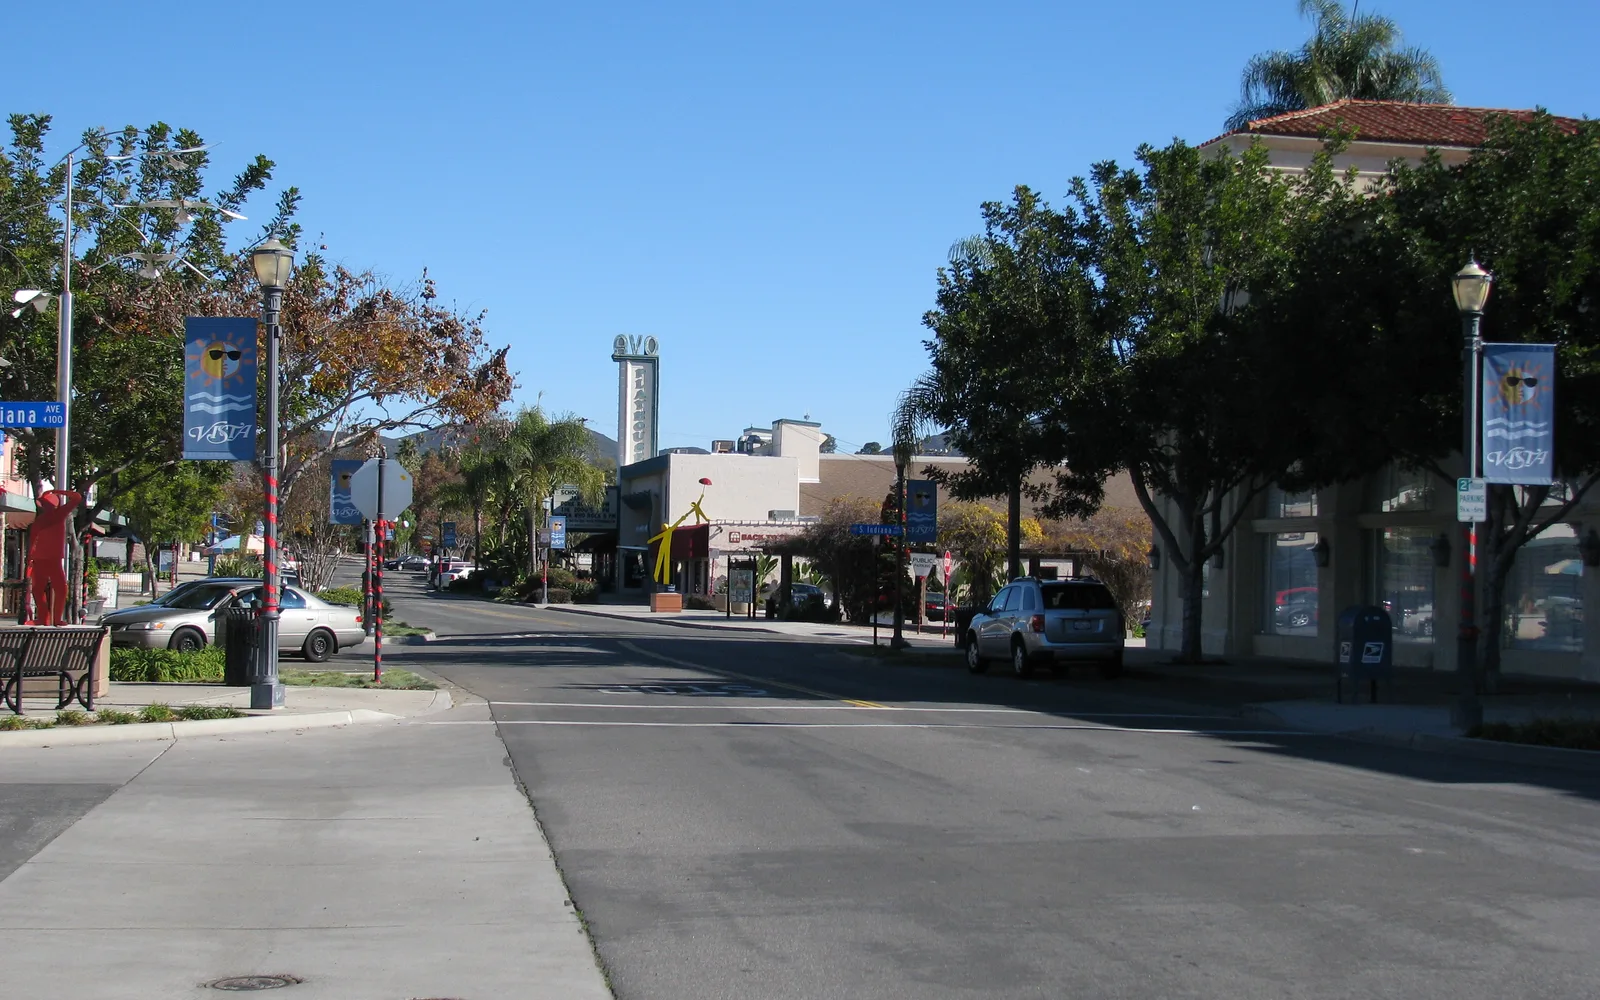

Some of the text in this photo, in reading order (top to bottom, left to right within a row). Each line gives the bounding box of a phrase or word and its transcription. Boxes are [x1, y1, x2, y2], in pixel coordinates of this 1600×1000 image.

[613, 334, 659, 355] AVO
[45, 405, 61, 413] AVE
[49, 416, 63, 424] 100
[633, 368, 646, 463] PLAYHOUSE
[188, 421, 252, 445] VISTA
[1486, 446, 1549, 470] VISTA
[1460, 480, 1468, 490] 2
[1459, 494, 1484, 503] PARKING
[867, 526, 892, 534] Indiana
